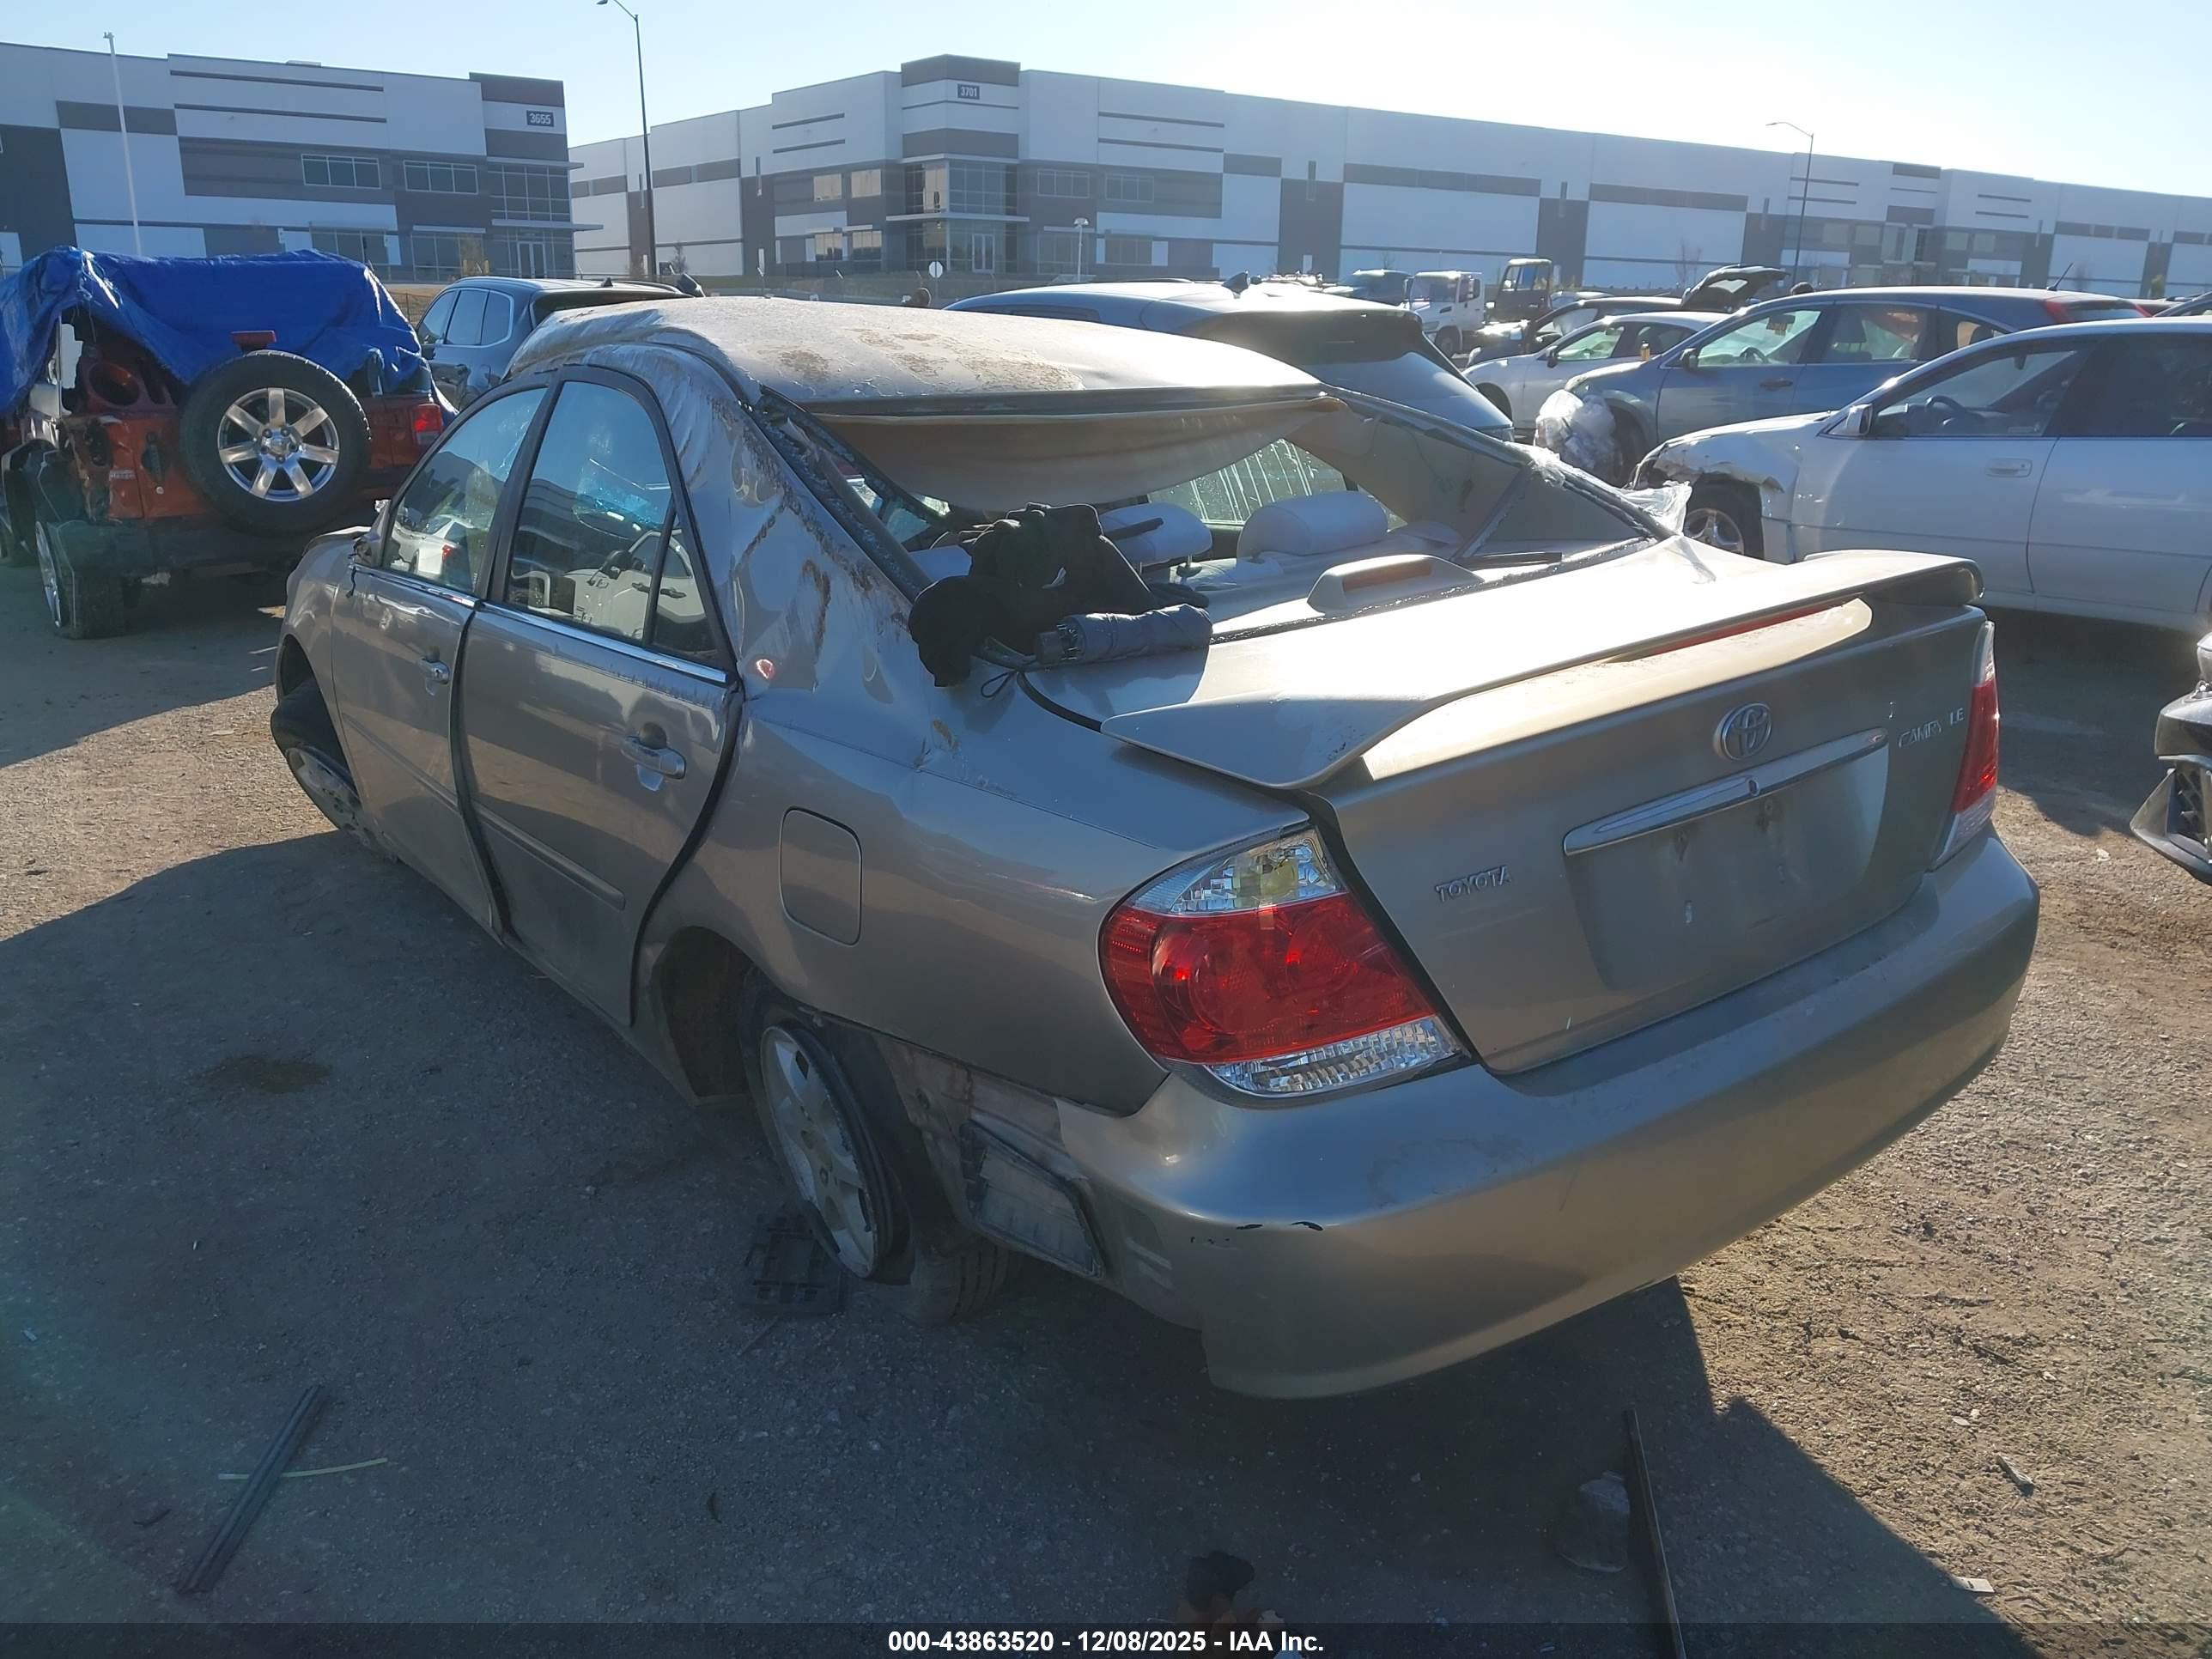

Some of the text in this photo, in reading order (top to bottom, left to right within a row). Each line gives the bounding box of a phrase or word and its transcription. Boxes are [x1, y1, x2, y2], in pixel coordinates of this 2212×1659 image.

[961, 86, 977, 97] 3701
[1950, 708, 1964, 726] LE
[1436, 866, 1511, 902] TOYOTA
